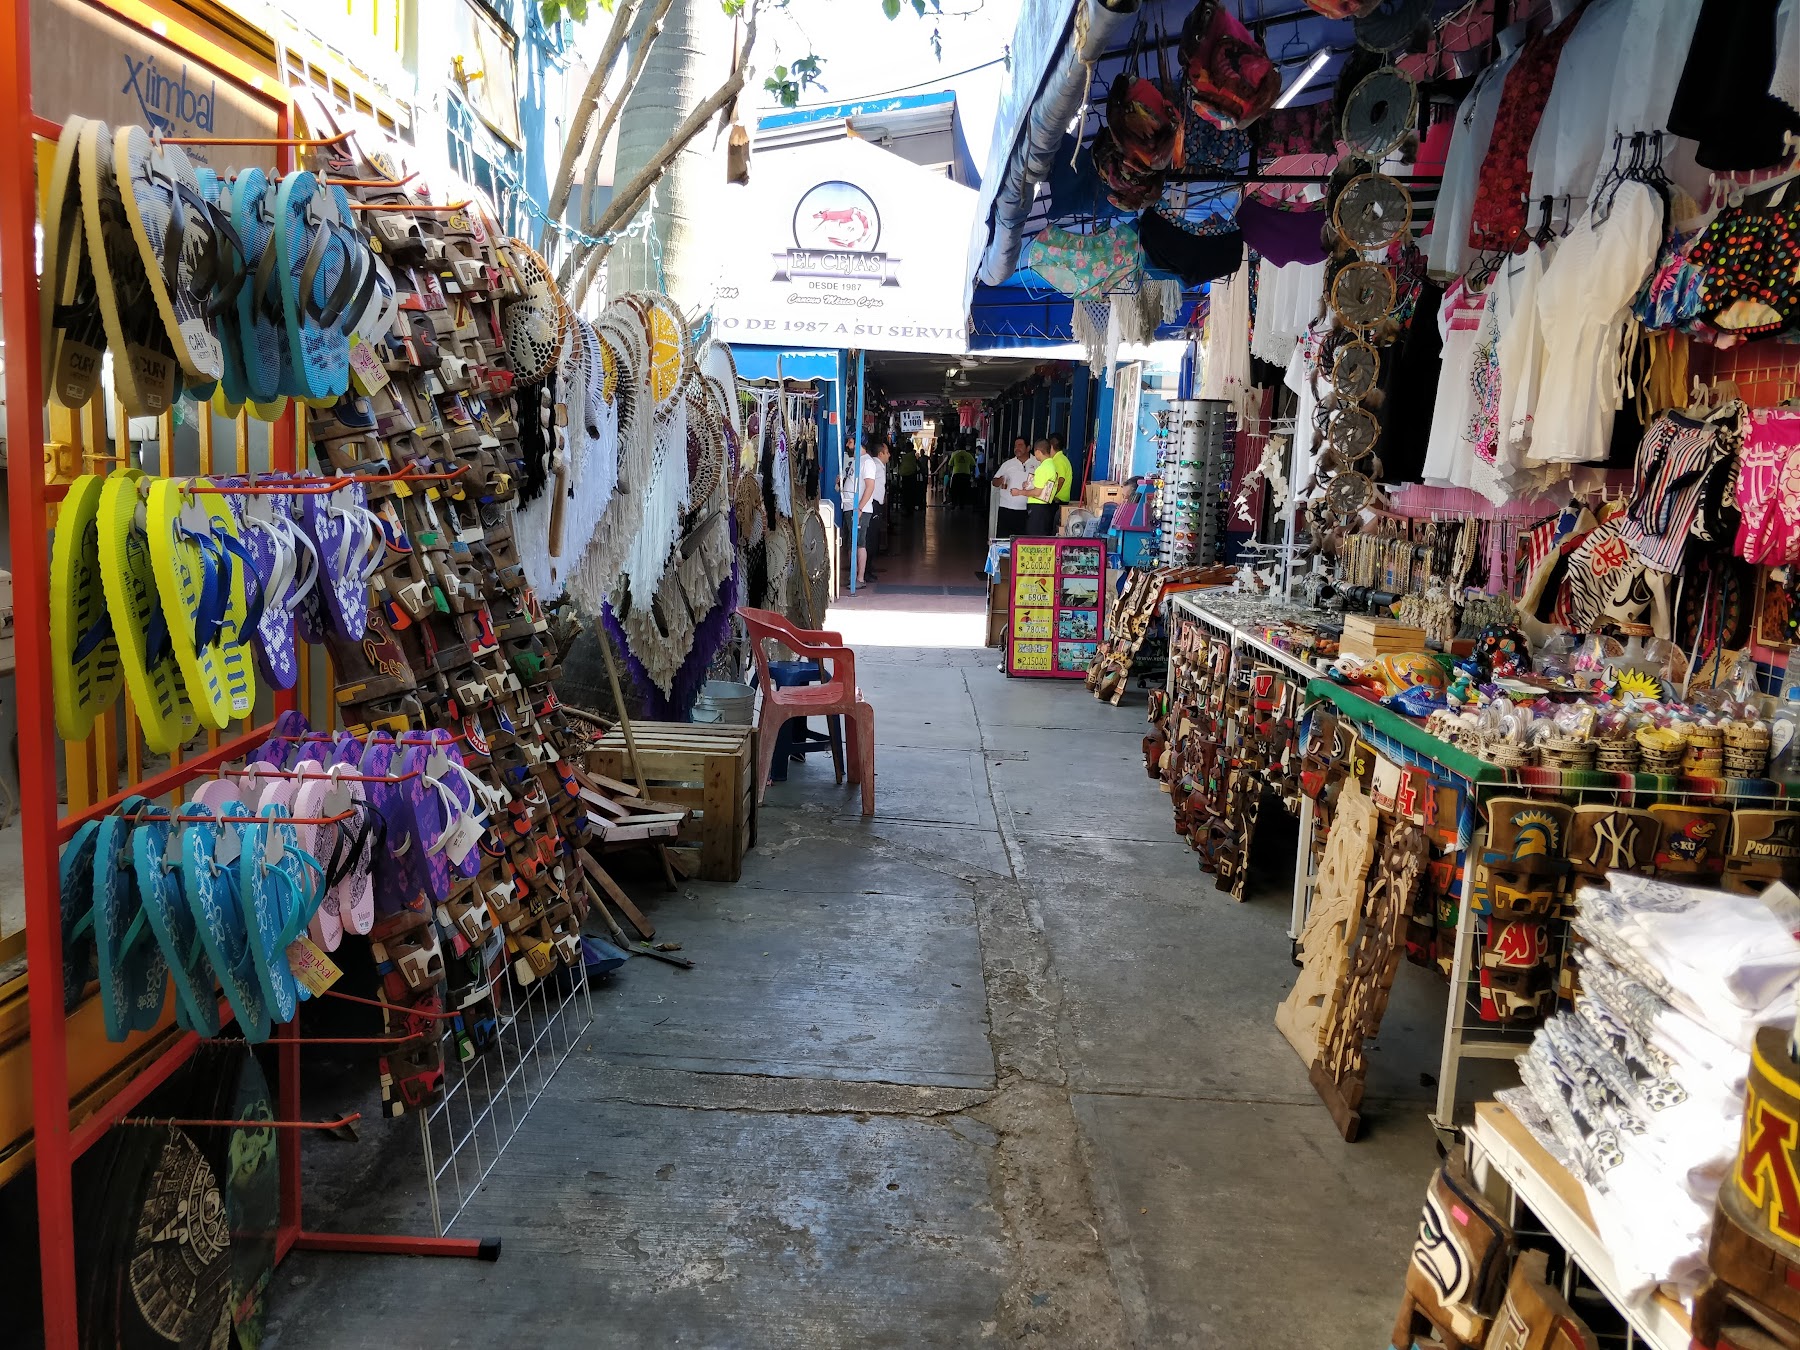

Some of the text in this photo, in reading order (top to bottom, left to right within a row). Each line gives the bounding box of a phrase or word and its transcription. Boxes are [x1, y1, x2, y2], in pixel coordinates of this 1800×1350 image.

[792, 252, 881, 275] EL CEJAS
[809, 282, 838, 290] DESDE
[746, 319, 776, 330] DE
[784, 321, 829, 333] 1987
[833, 322, 849, 334] A
[853, 324, 882, 335] SU
[1589, 811, 1641, 869] NY
[1680, 841, 1697, 851] KU
